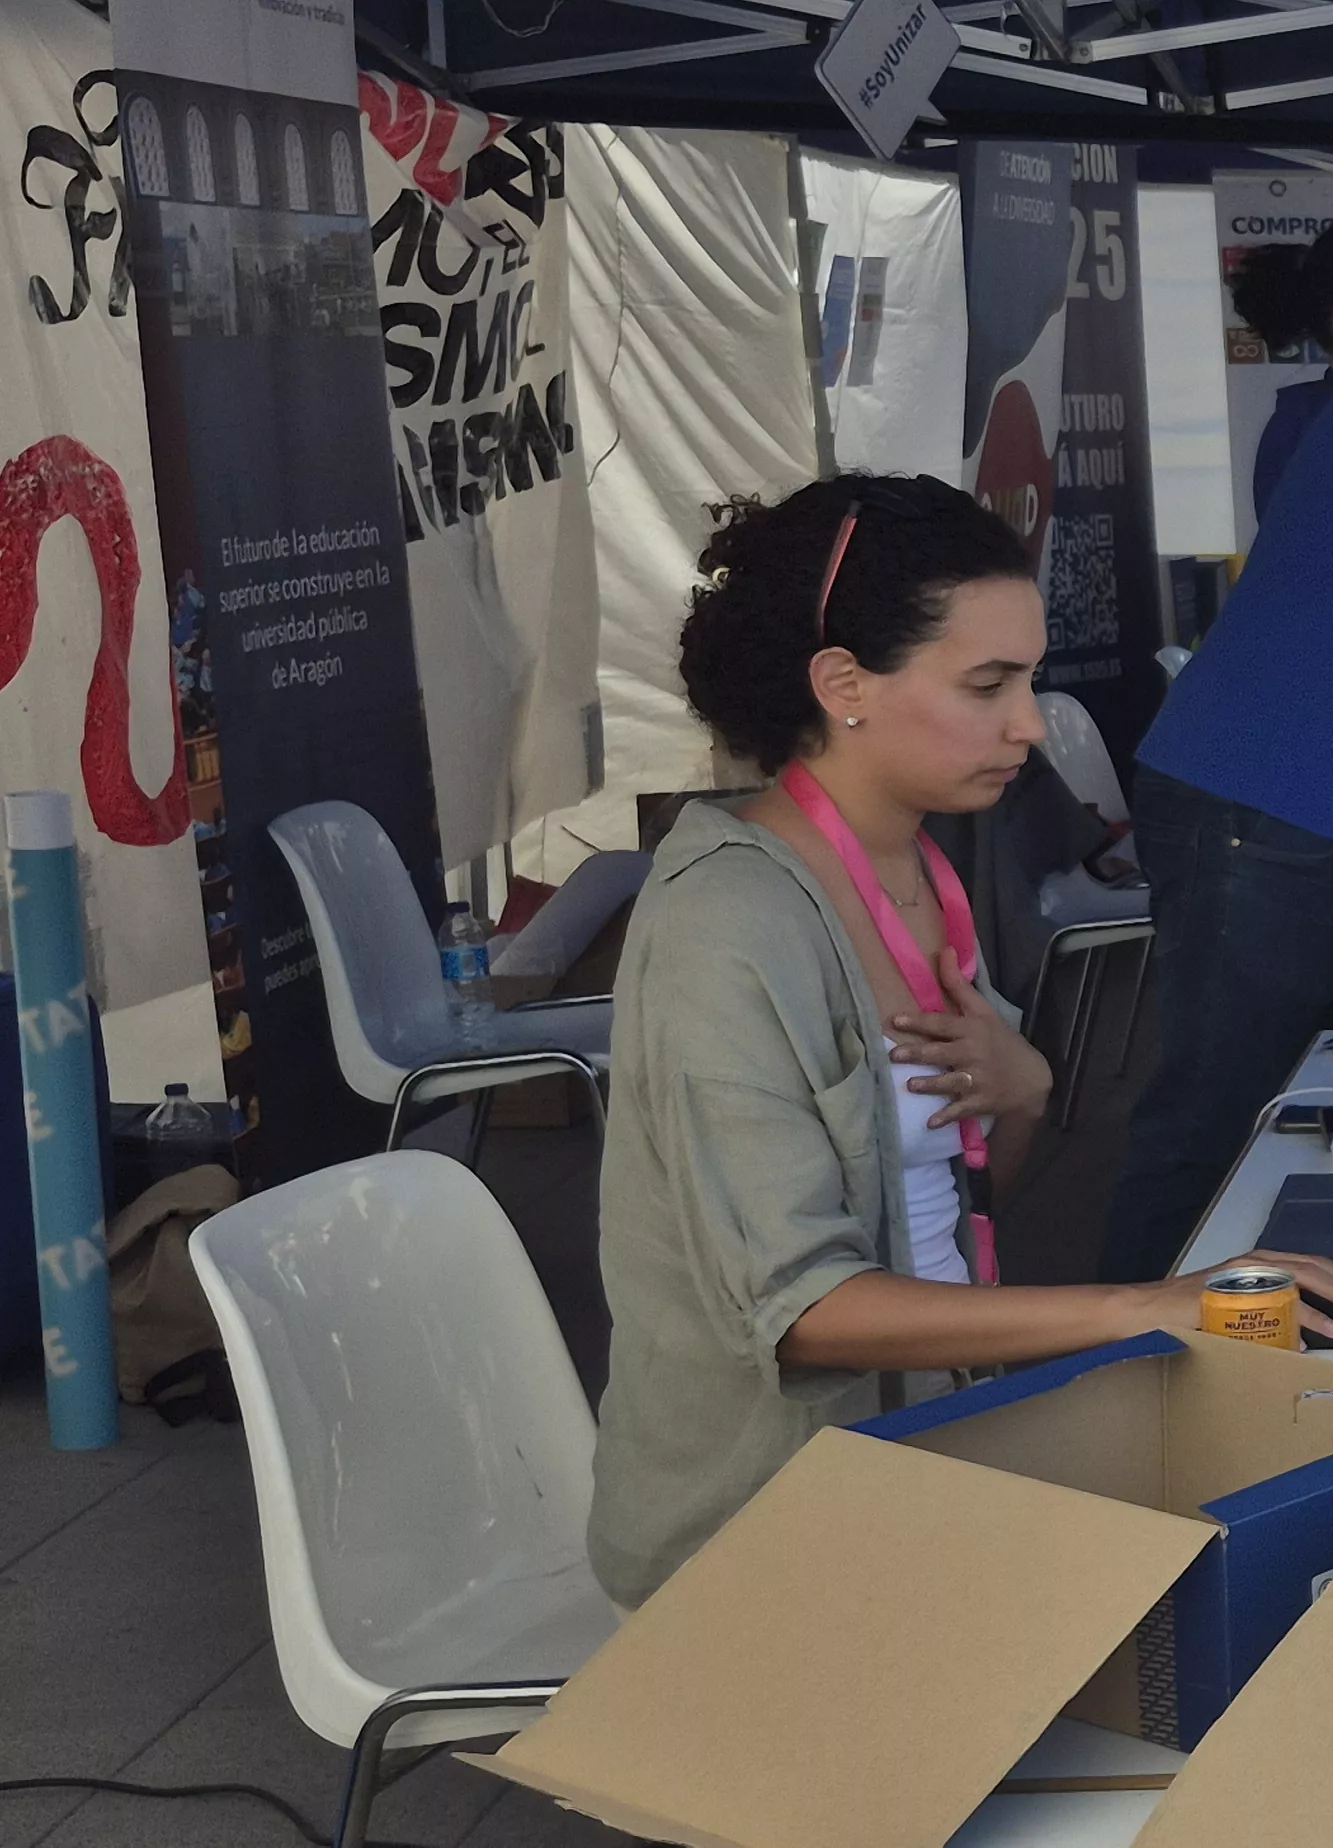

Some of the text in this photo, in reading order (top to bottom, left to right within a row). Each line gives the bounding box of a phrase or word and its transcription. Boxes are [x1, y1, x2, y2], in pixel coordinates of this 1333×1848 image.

[859, 3, 927, 110] #SoyUnizar
[1077, 442, 1126, 490] AQUÍ
[221, 521, 380, 567] El futuro de la educación
[219, 559, 391, 615] superior se construye en la
[241, 606, 368, 653] universidad pública
[272, 651, 343, 690] de Aragón
[1225, 1319, 1281, 1331] NUESTRO
[1239, 1312, 1266, 1321] MUY
